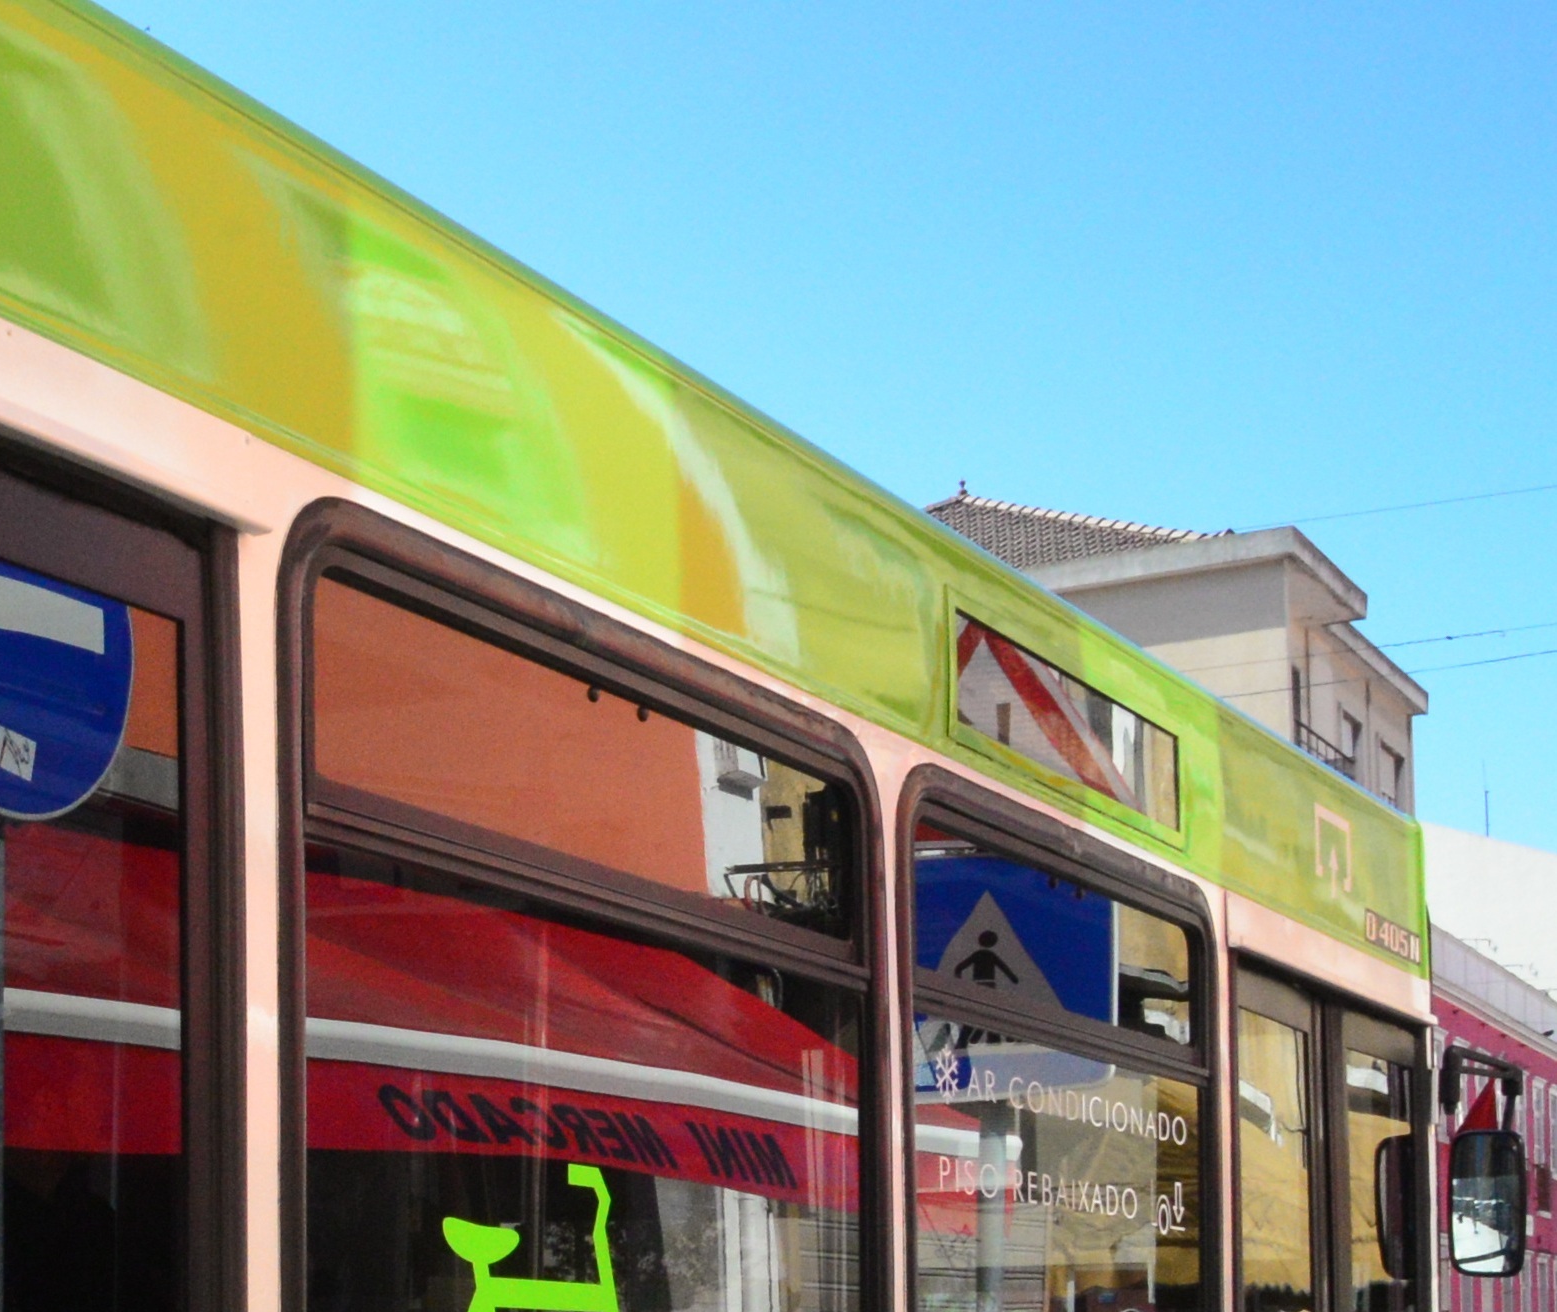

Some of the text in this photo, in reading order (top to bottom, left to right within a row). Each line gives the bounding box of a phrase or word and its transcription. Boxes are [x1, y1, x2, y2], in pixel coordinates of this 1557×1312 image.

[967, 1070, 1187, 1146] AR CONDICIONADO
[938, 1155, 1138, 1220] PISO REBAIXADO
